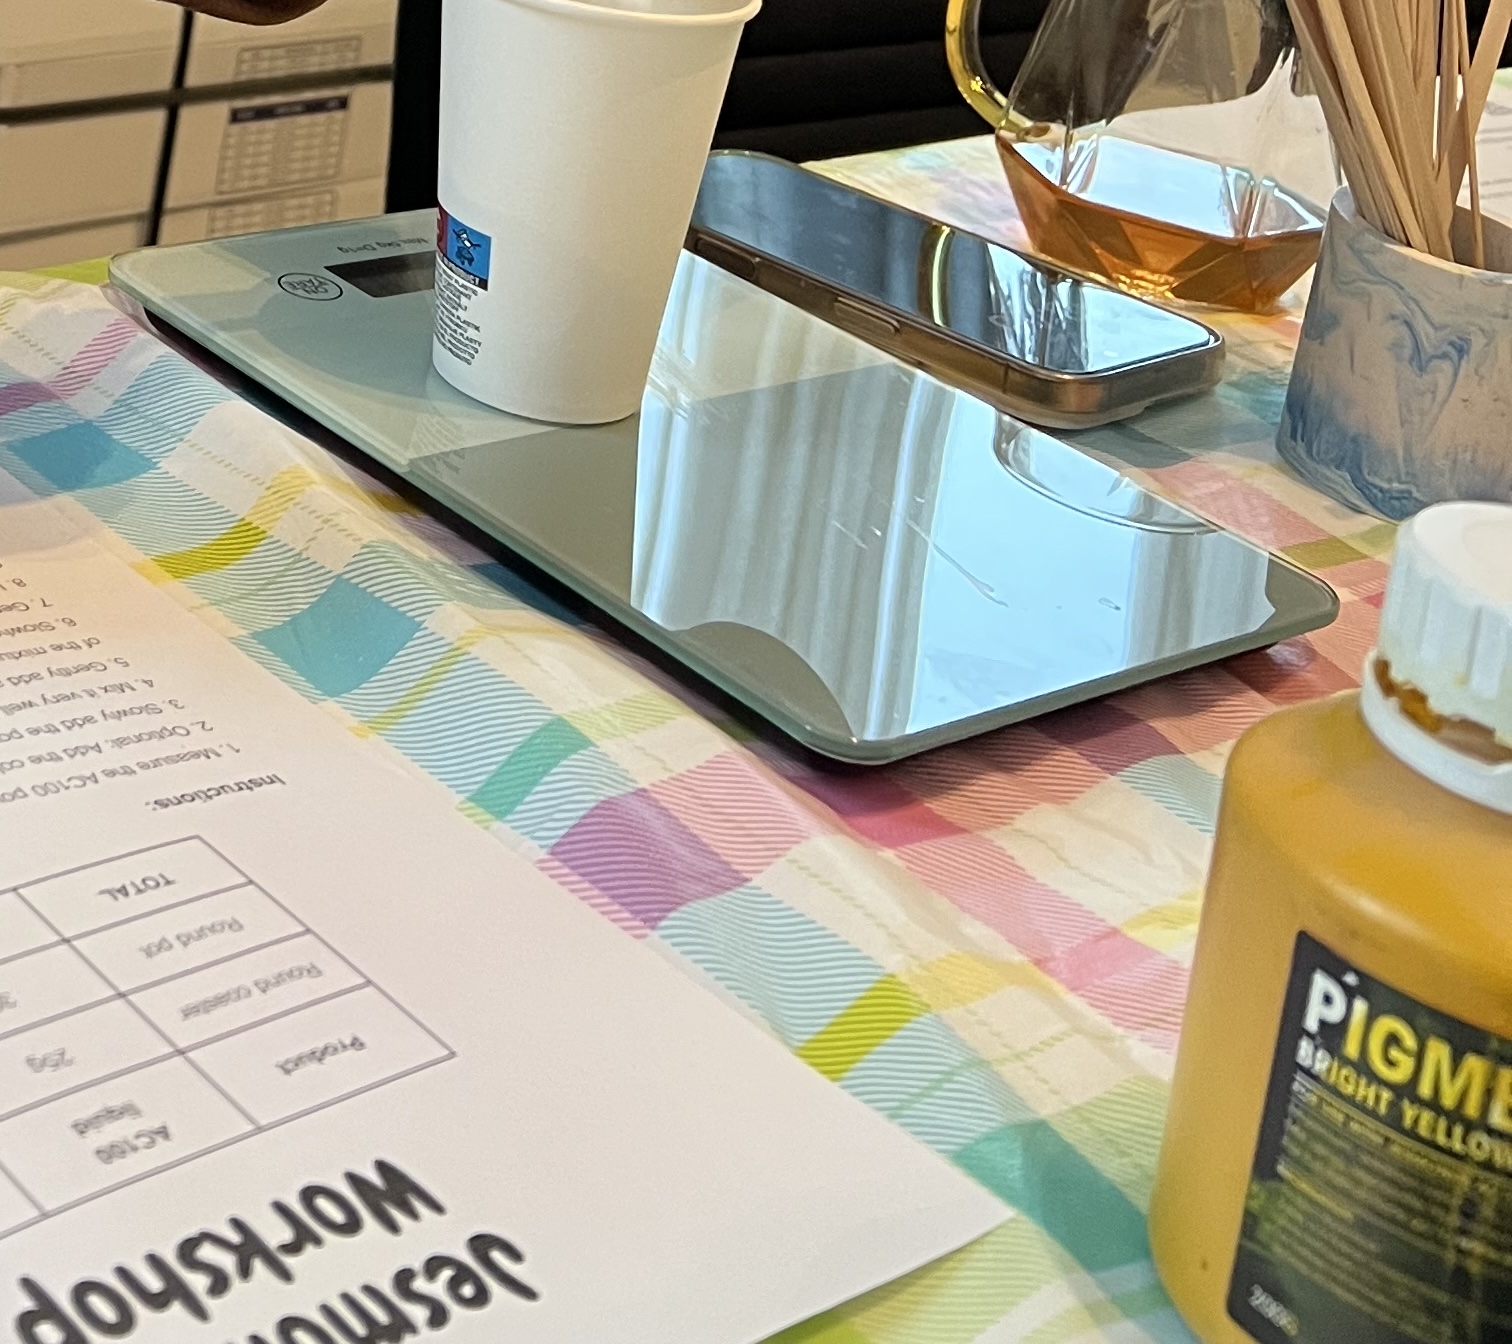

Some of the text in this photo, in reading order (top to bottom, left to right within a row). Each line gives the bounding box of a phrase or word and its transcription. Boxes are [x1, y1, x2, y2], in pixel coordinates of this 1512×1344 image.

[48, 640, 82, 652] the
[81, 636, 101, 648] of
[45, 659, 108, 678] Gently
[5, 672, 45, 686] add
[97, 681, 136, 694] Mix
[38, 689, 82, 704] very
[81, 688, 100, 698] it
[98, 701, 163, 721] Slowly
[24, 722, 61, 736] the
[59, 714, 99, 730] add
[103, 723, 191, 749] Optional:
[27, 751, 63, 765] the
[62, 742, 103, 758] Add
[135, 747, 221, 771] Measure
[100, 764, 137, 779] the
[30, 772, 100, 796] AC100
[144, 774, 285, 811] Instructions:
[97, 872, 176, 901] TOTAL
[174, 916, 244, 948] Round
[252, 961, 323, 994] Round
[275, 1035, 366, 1075] Product
[94, 1124, 171, 1164] AC100
[15, 1158, 447, 1344] Workshop
